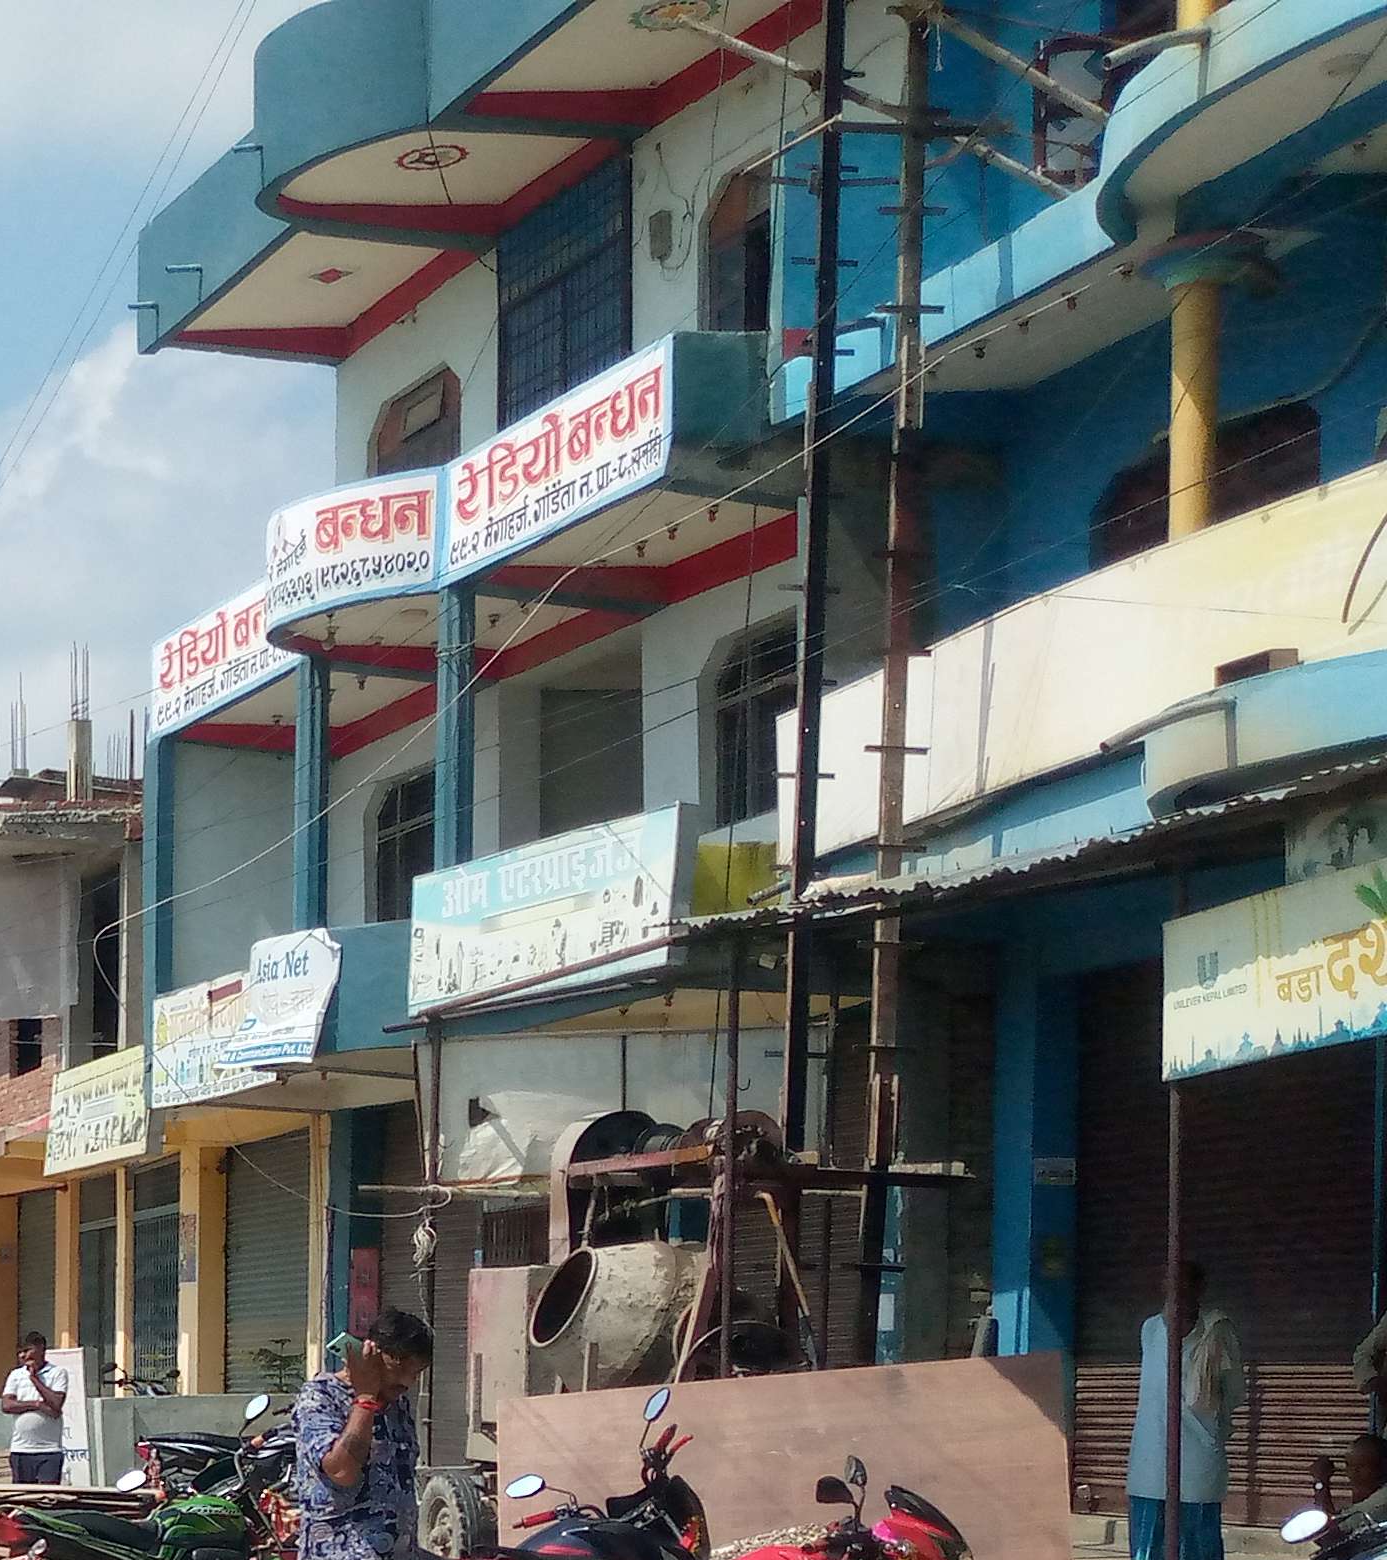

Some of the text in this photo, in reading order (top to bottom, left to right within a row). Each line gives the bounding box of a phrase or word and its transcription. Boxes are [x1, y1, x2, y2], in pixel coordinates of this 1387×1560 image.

[456, 364, 663, 522] रेडियो बन्धन
[315, 489, 431, 550] बन्धन
[159, 611, 228, 690] रेडियो
[441, 866, 490, 919] ओम
[256, 950, 310, 984] Asia Net
[1274, 964, 1324, 1003] बडा
[297, 1042, 314, 1055] Ltd
